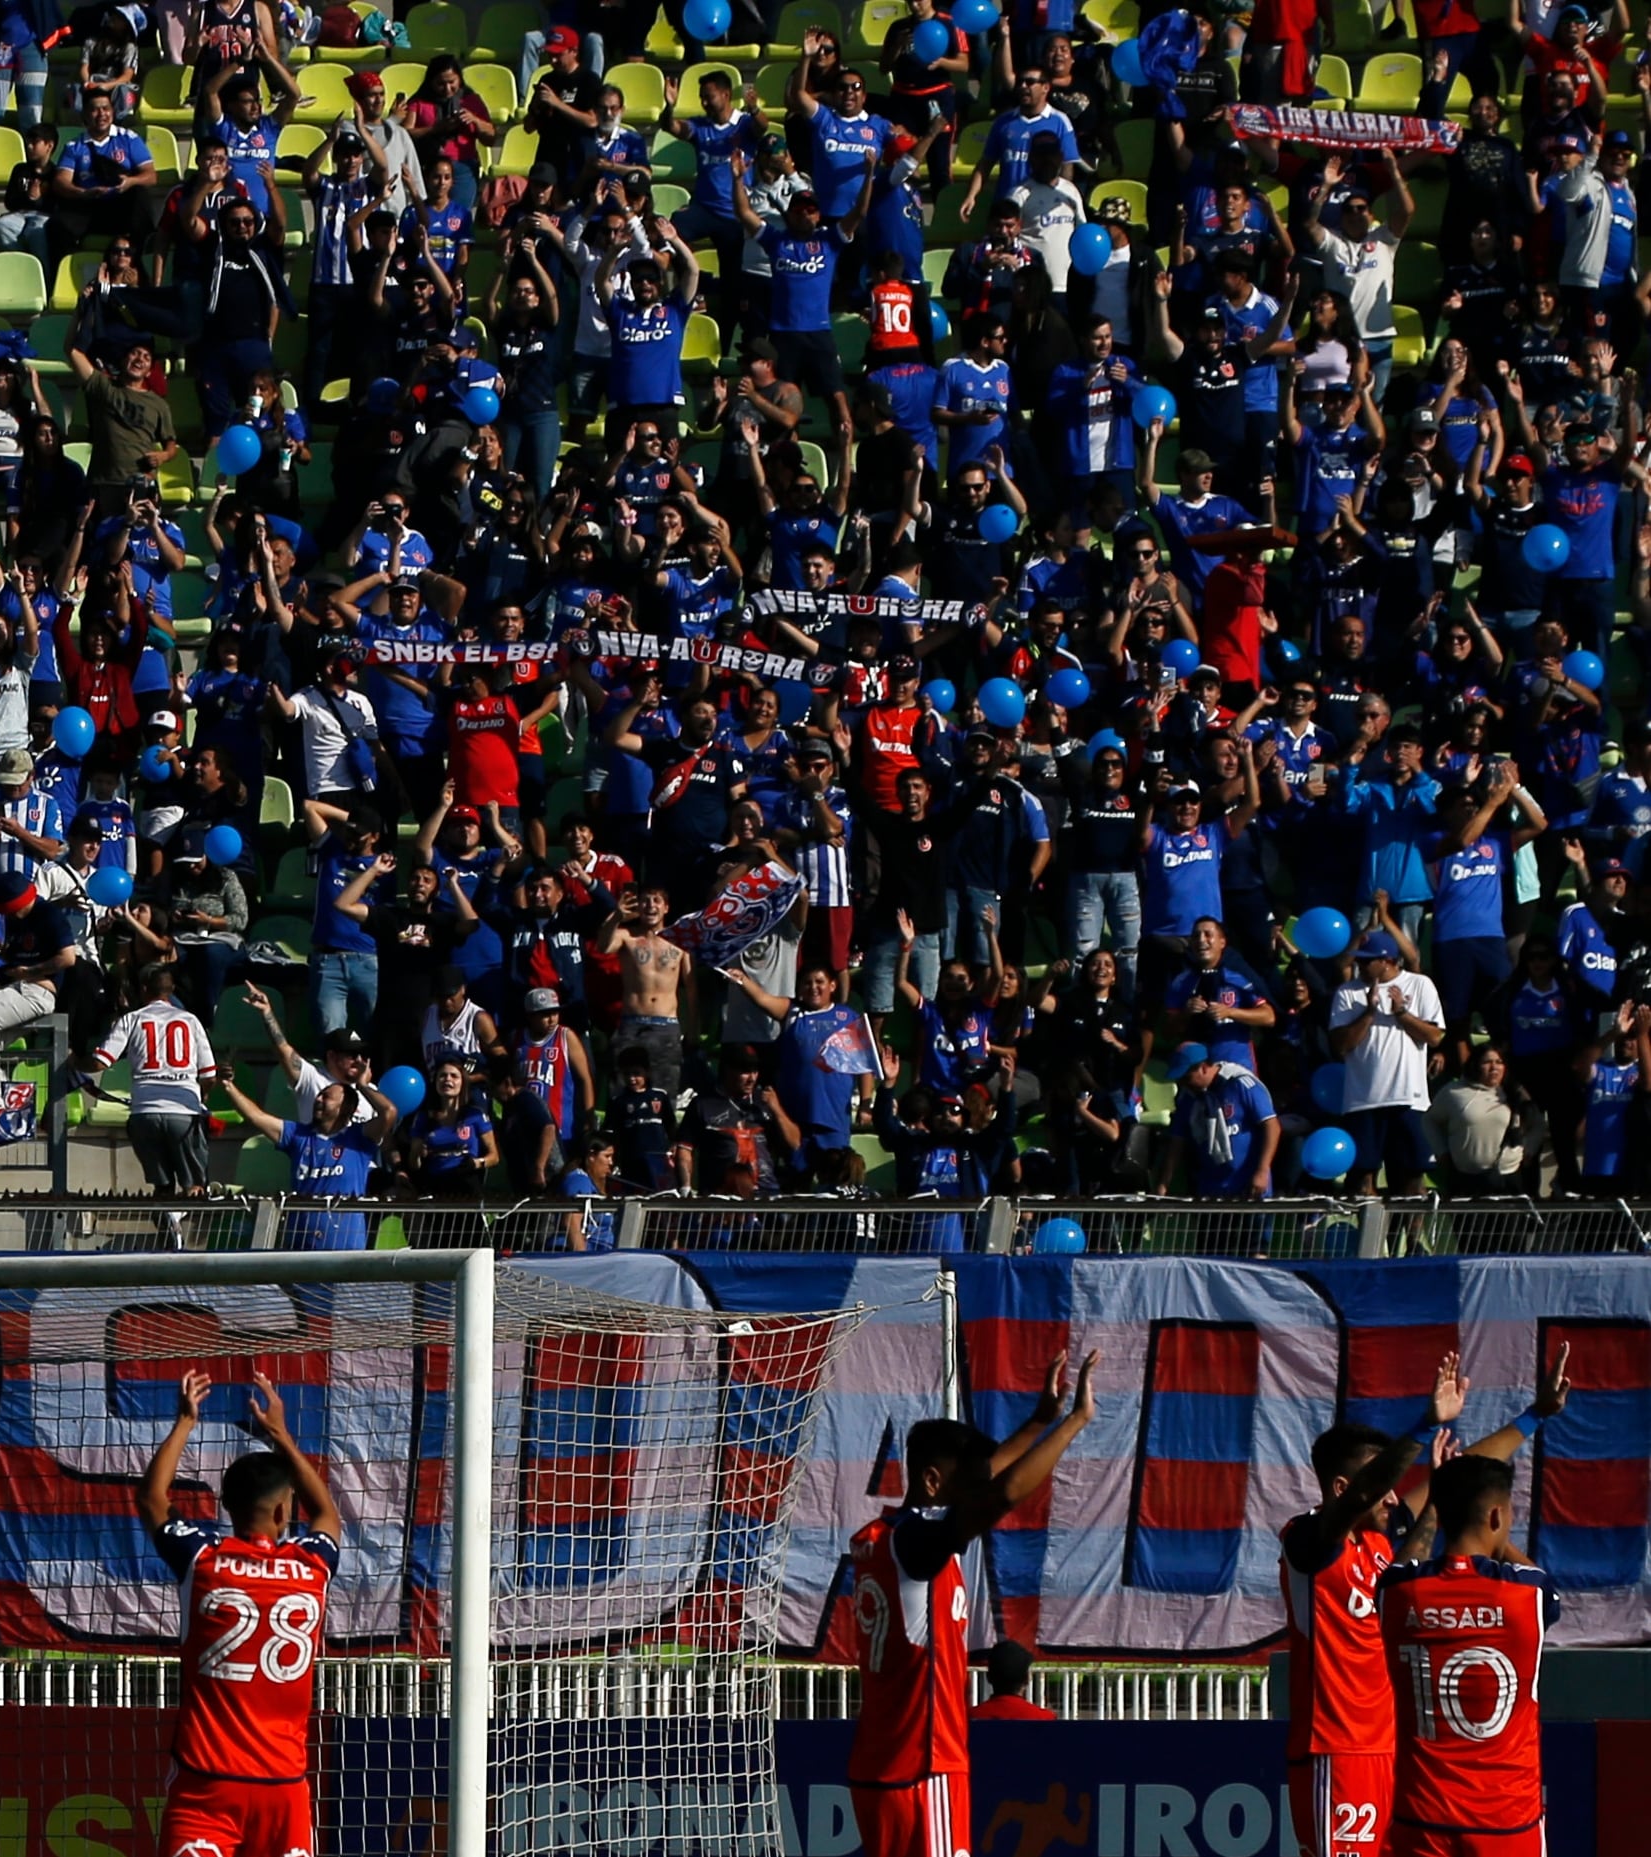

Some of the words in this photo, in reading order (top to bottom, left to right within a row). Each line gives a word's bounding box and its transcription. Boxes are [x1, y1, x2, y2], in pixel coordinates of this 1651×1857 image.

[619, 321, 671, 342] Claro
[880, 302, 915, 332] 10
[373, 639, 458, 662] SNBK
[464, 643, 500, 662] EL
[597, 630, 660, 658] NVA
[141, 1019, 192, 1071] 10
[213, 1555, 316, 1582] POBLETE
[1405, 1605, 1505, 1631] ASSADI
[198, 1586, 321, 1684] 28
[1399, 1644, 1519, 1743] 10
[1334, 1802, 1377, 1844] 22
